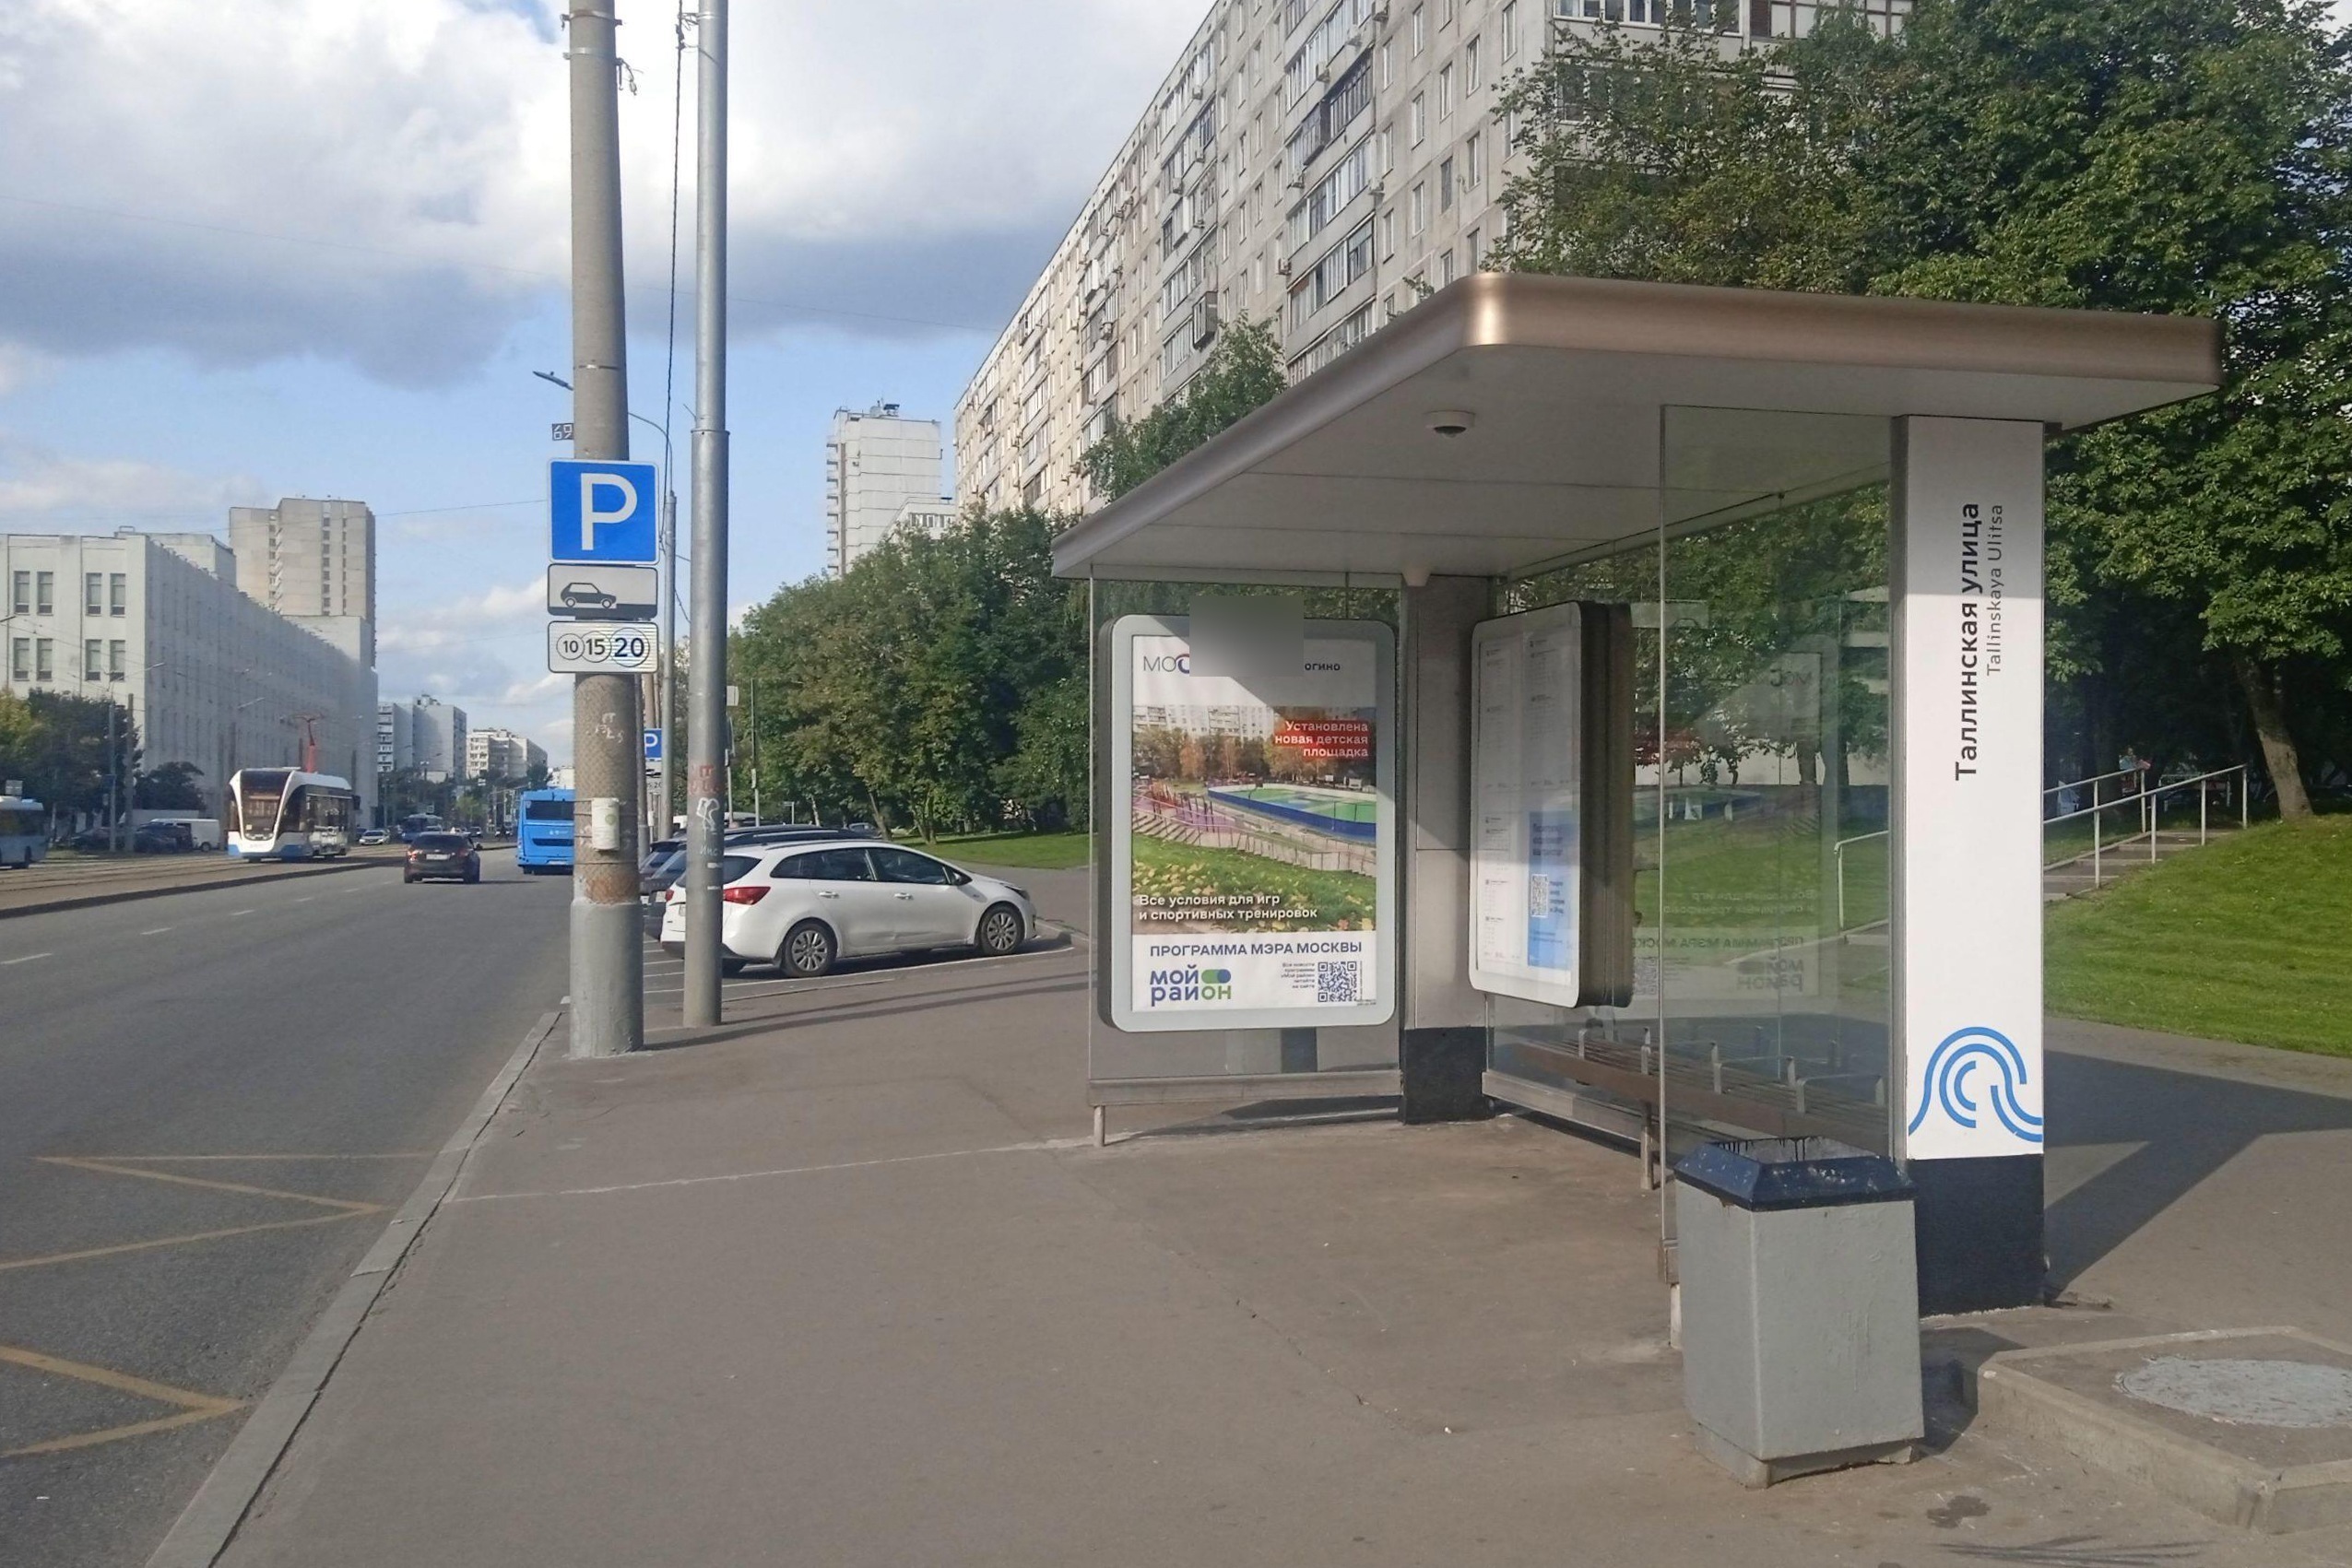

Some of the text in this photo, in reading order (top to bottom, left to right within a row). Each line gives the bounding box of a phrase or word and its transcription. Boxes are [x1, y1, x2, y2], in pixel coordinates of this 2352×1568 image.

[554, 425, 572, 439] 69
[581, 473, 637, 550] P
[1986, 505, 2004, 676] Tallinskaya Ulitsa
[562, 637, 644, 658] 10 15 20
[1955, 504, 1983, 781] Таллинская улица
[1304, 663, 1341, 671] огино
[1285, 721, 1368, 731] Установлена
[644, 733, 657, 755] P
[1275, 735, 1368, 745] новая детская
[1303, 748, 1368, 758] площадка
[1140, 895, 1280, 908] Все условия для игр
[1140, 909, 1318, 922] и спортивных тренировок
[1150, 941, 1362, 956] ПРОГРАММА МЭРА МОСКВЫ
[1150, 964, 1199, 984] мой
